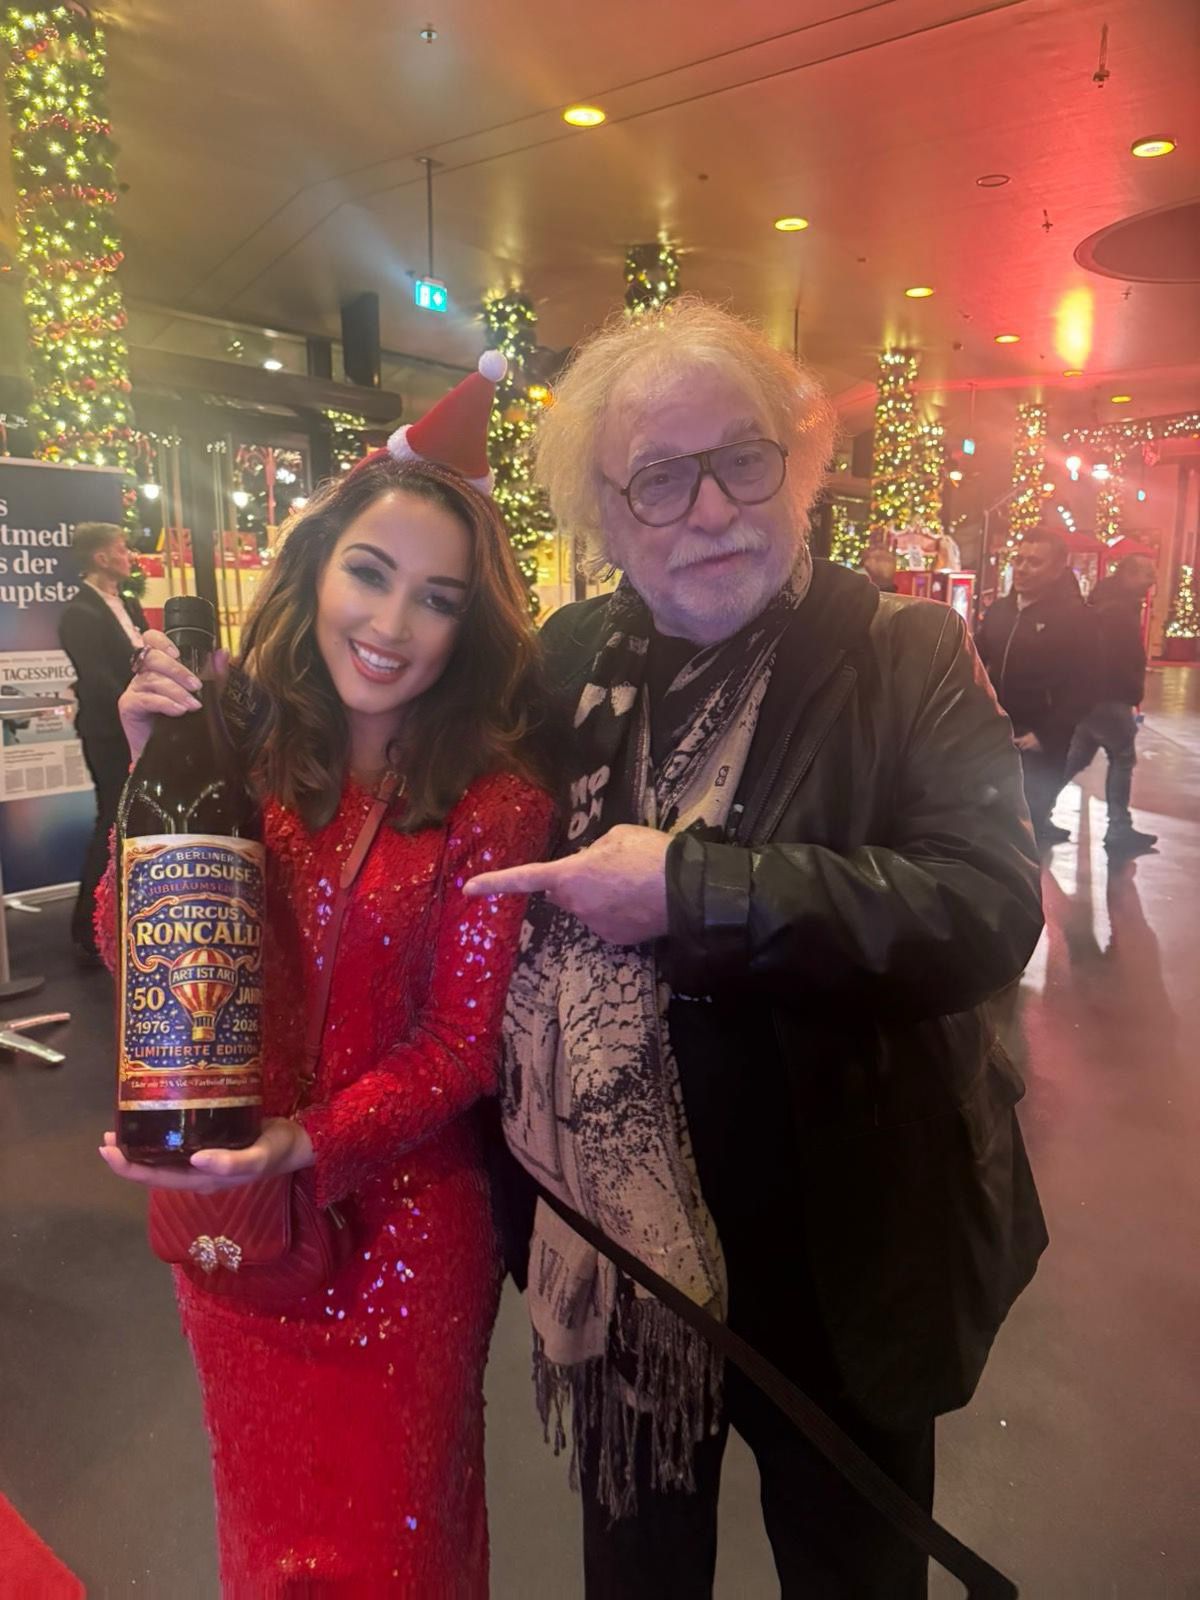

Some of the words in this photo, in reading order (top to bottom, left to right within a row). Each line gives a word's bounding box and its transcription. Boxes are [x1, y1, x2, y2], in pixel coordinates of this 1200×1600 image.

[12, 549, 58, 575] der
[3, 665, 76, 681] TAGESSPIEG
[176, 851, 234, 863] BERLINER
[150, 863, 253, 883] GOLDSUSE
[169, 905, 239, 921] CIRCUS
[172, 969, 193, 983] ART
[196, 967, 214, 979] IST
[216, 968, 236, 983] ART
[132, 987, 166, 1011] 50
[136, 1020, 170, 1034] 1976
[134, 1045, 210, 1058] LIMITIERTE
